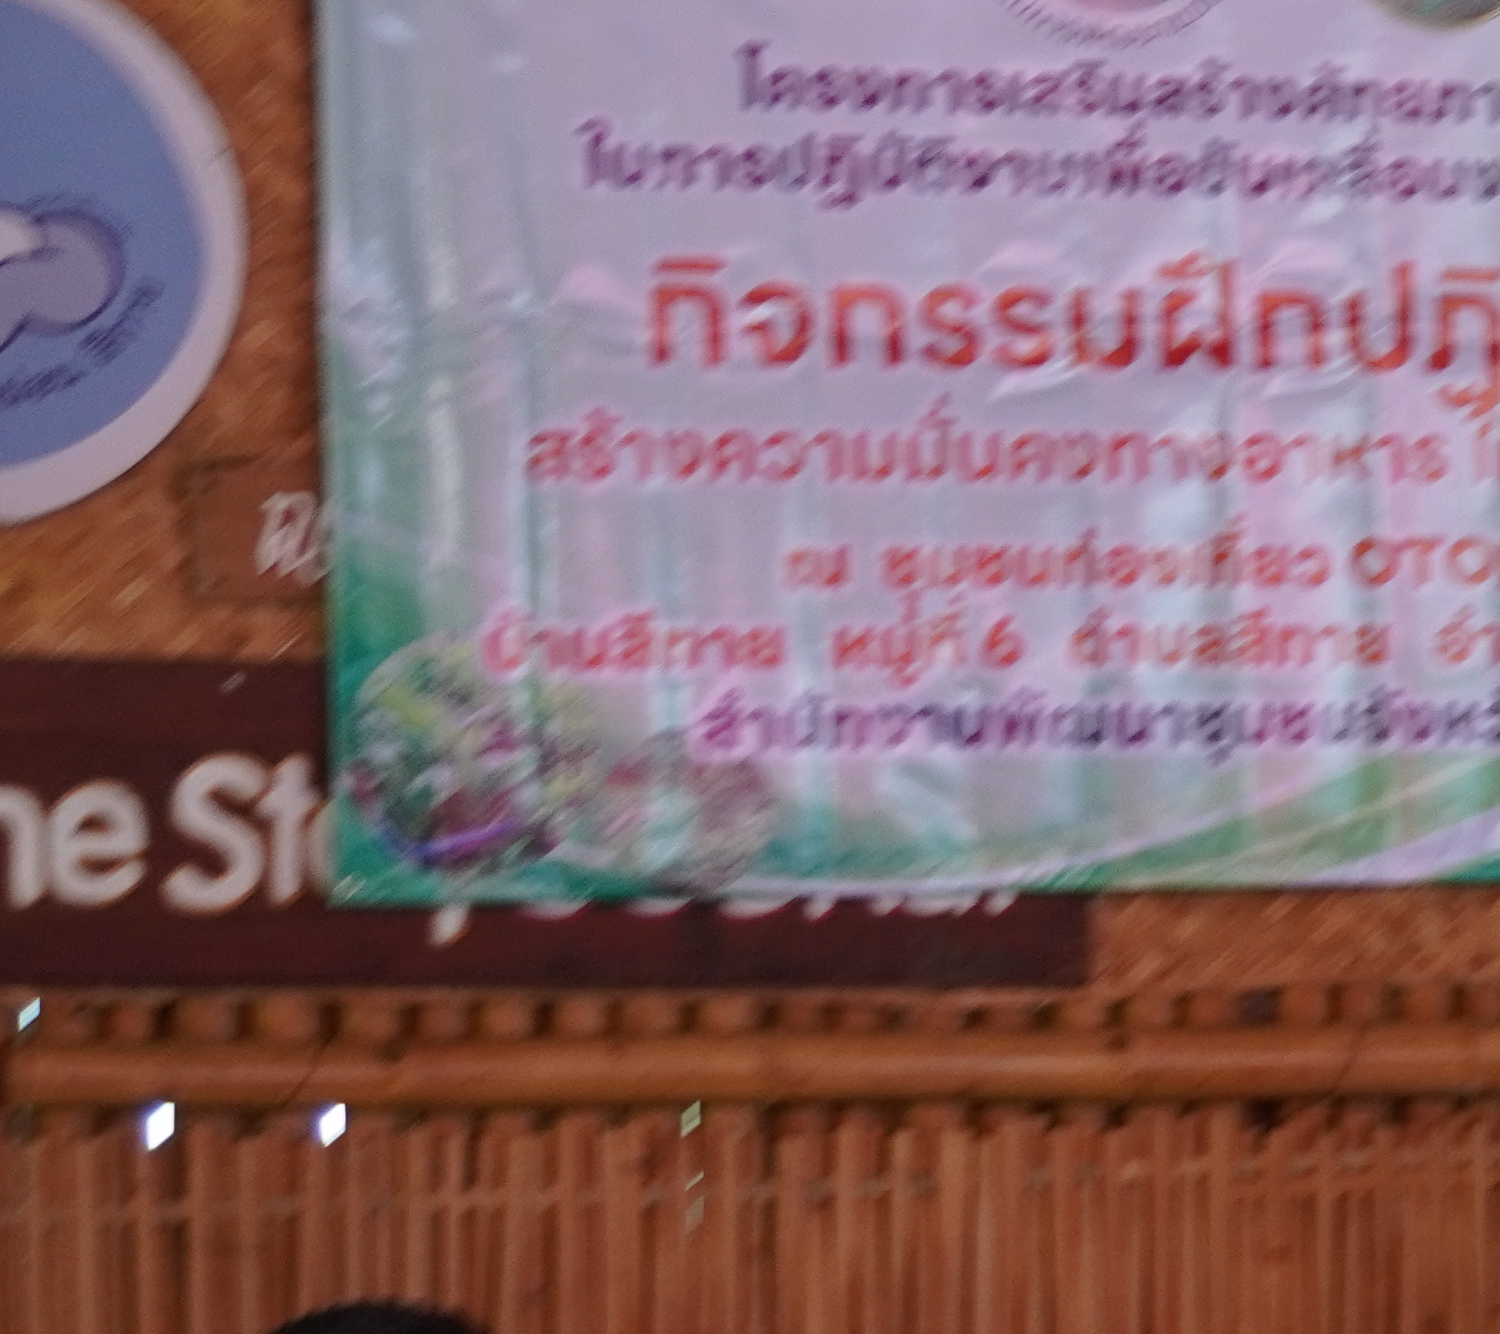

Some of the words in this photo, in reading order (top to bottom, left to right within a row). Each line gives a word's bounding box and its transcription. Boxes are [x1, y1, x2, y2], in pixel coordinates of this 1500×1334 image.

[526, 393, 1451, 487] สร้างความมั่นคงทางอาหาร
[783, 541, 848, 588] ณ
[981, 612, 1025, 668] 6
